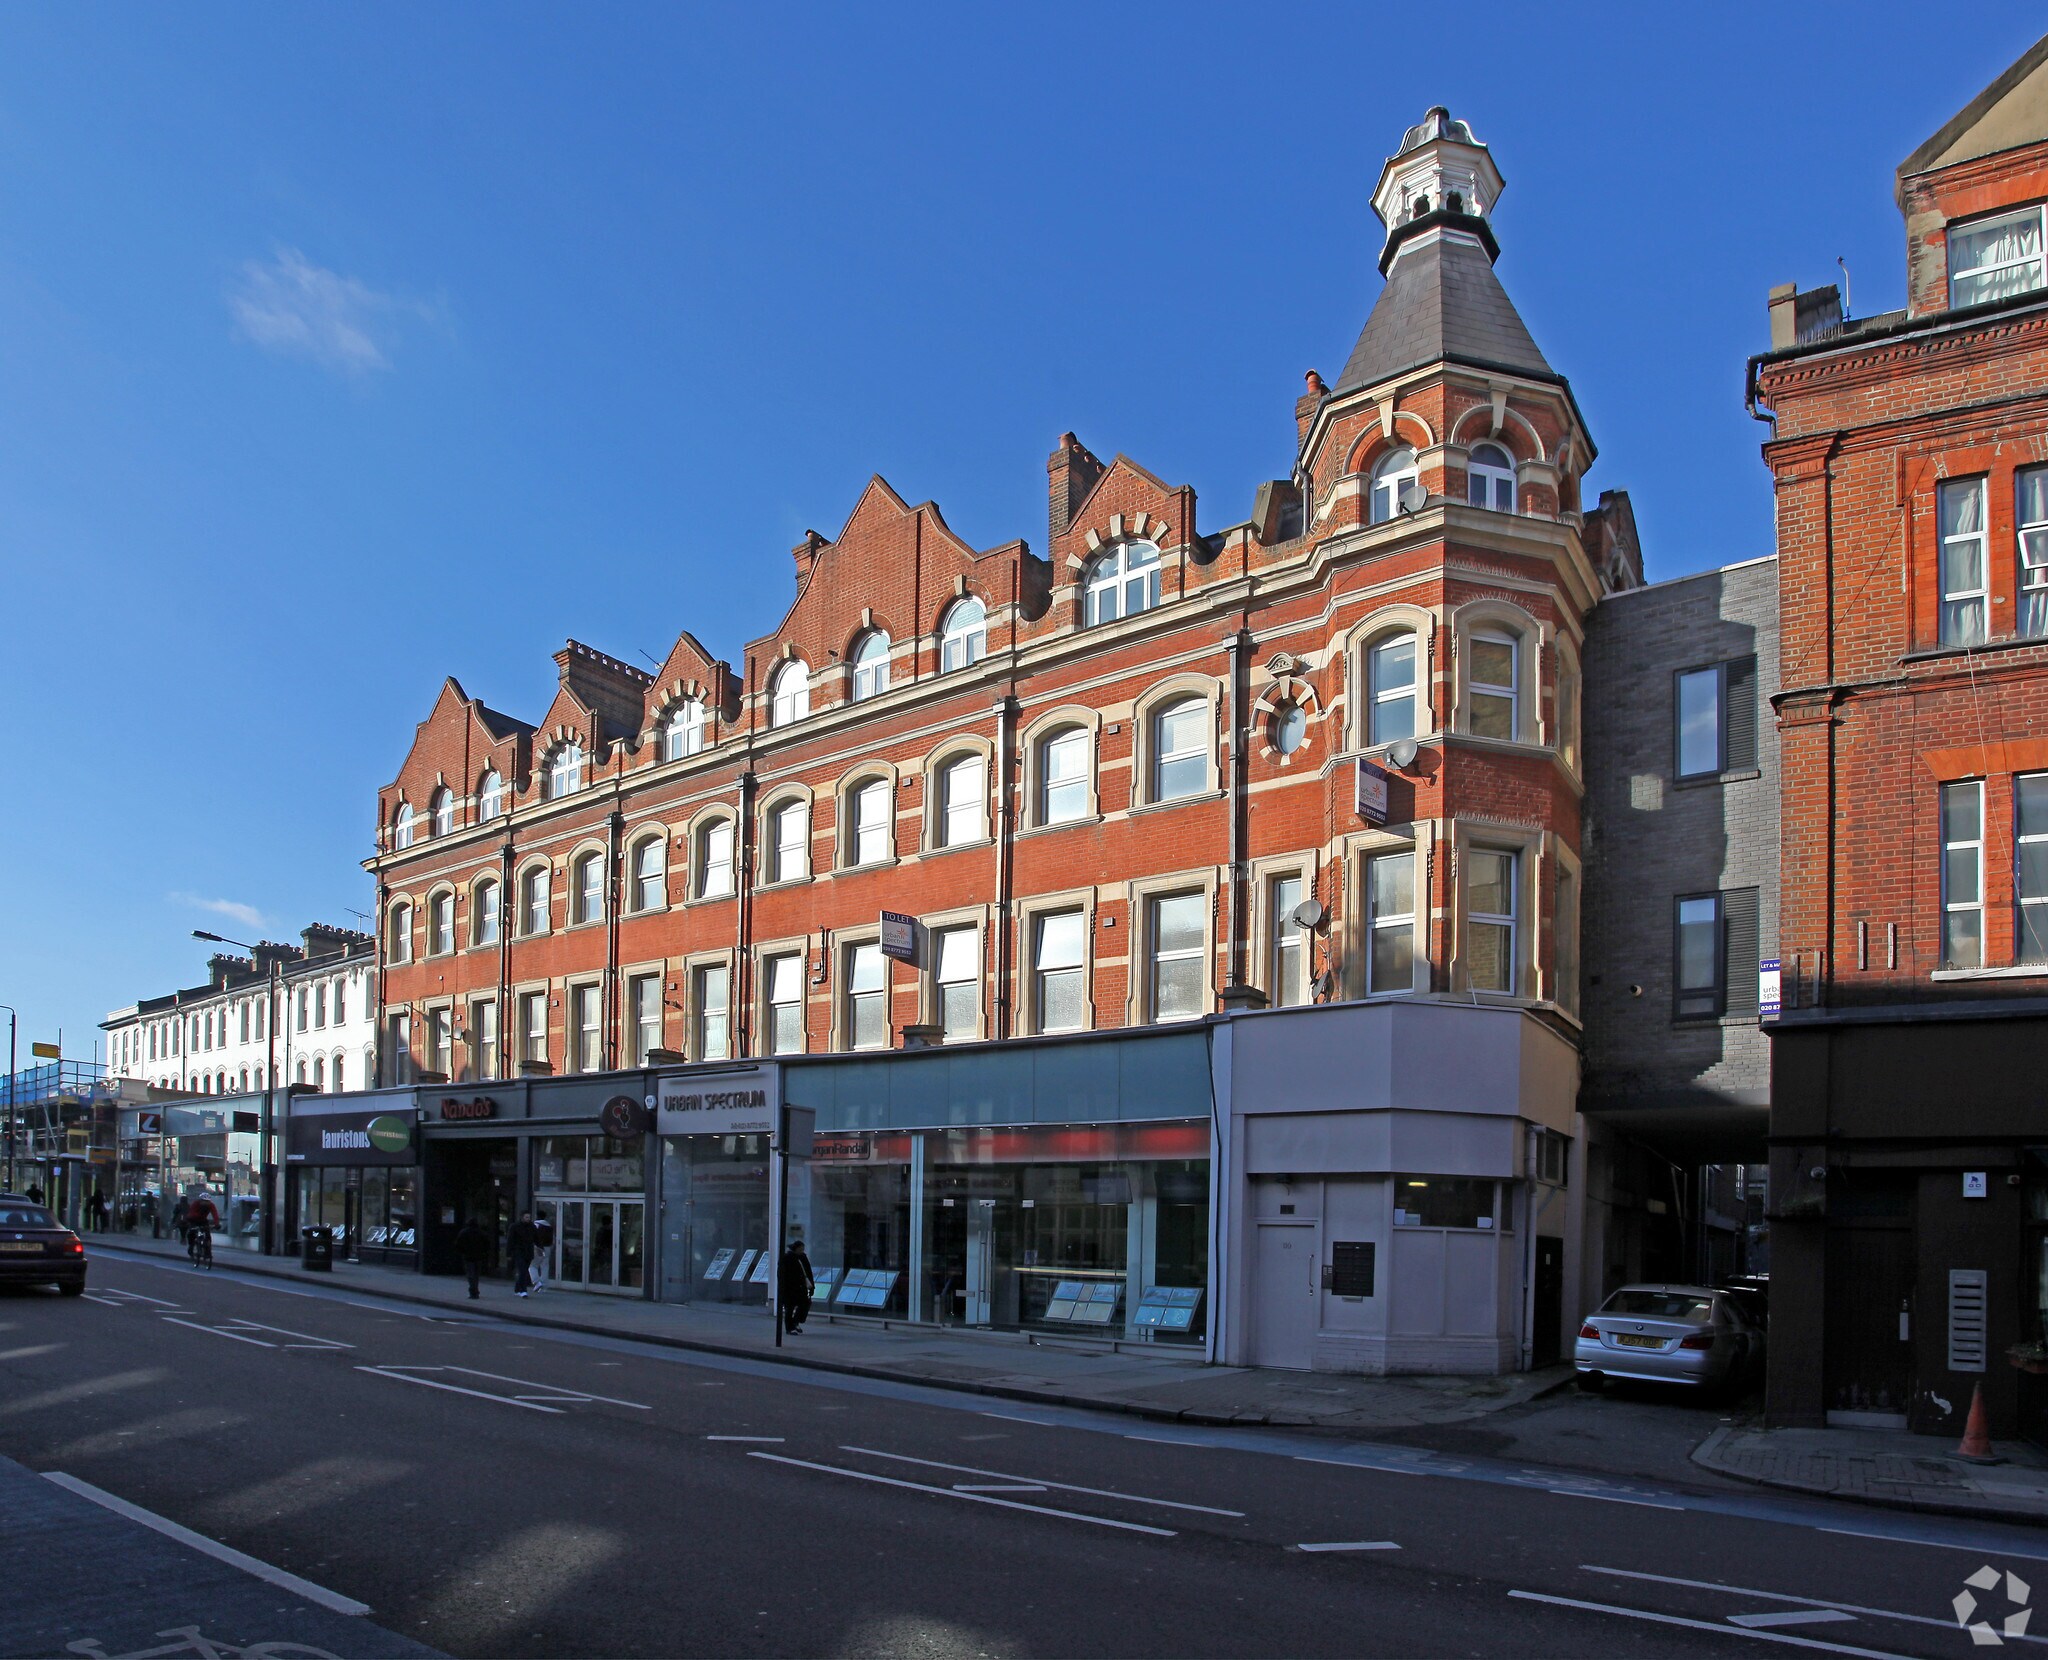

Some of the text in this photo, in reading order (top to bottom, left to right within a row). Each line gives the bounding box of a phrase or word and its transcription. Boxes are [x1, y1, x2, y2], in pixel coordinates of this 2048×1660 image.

[886, 912, 910, 923] TO LET
[441, 1098, 493, 1119] Nando's
[664, 1090, 767, 1112] URBAN SPECTRUM
[322, 1129, 370, 1149] lauristons
